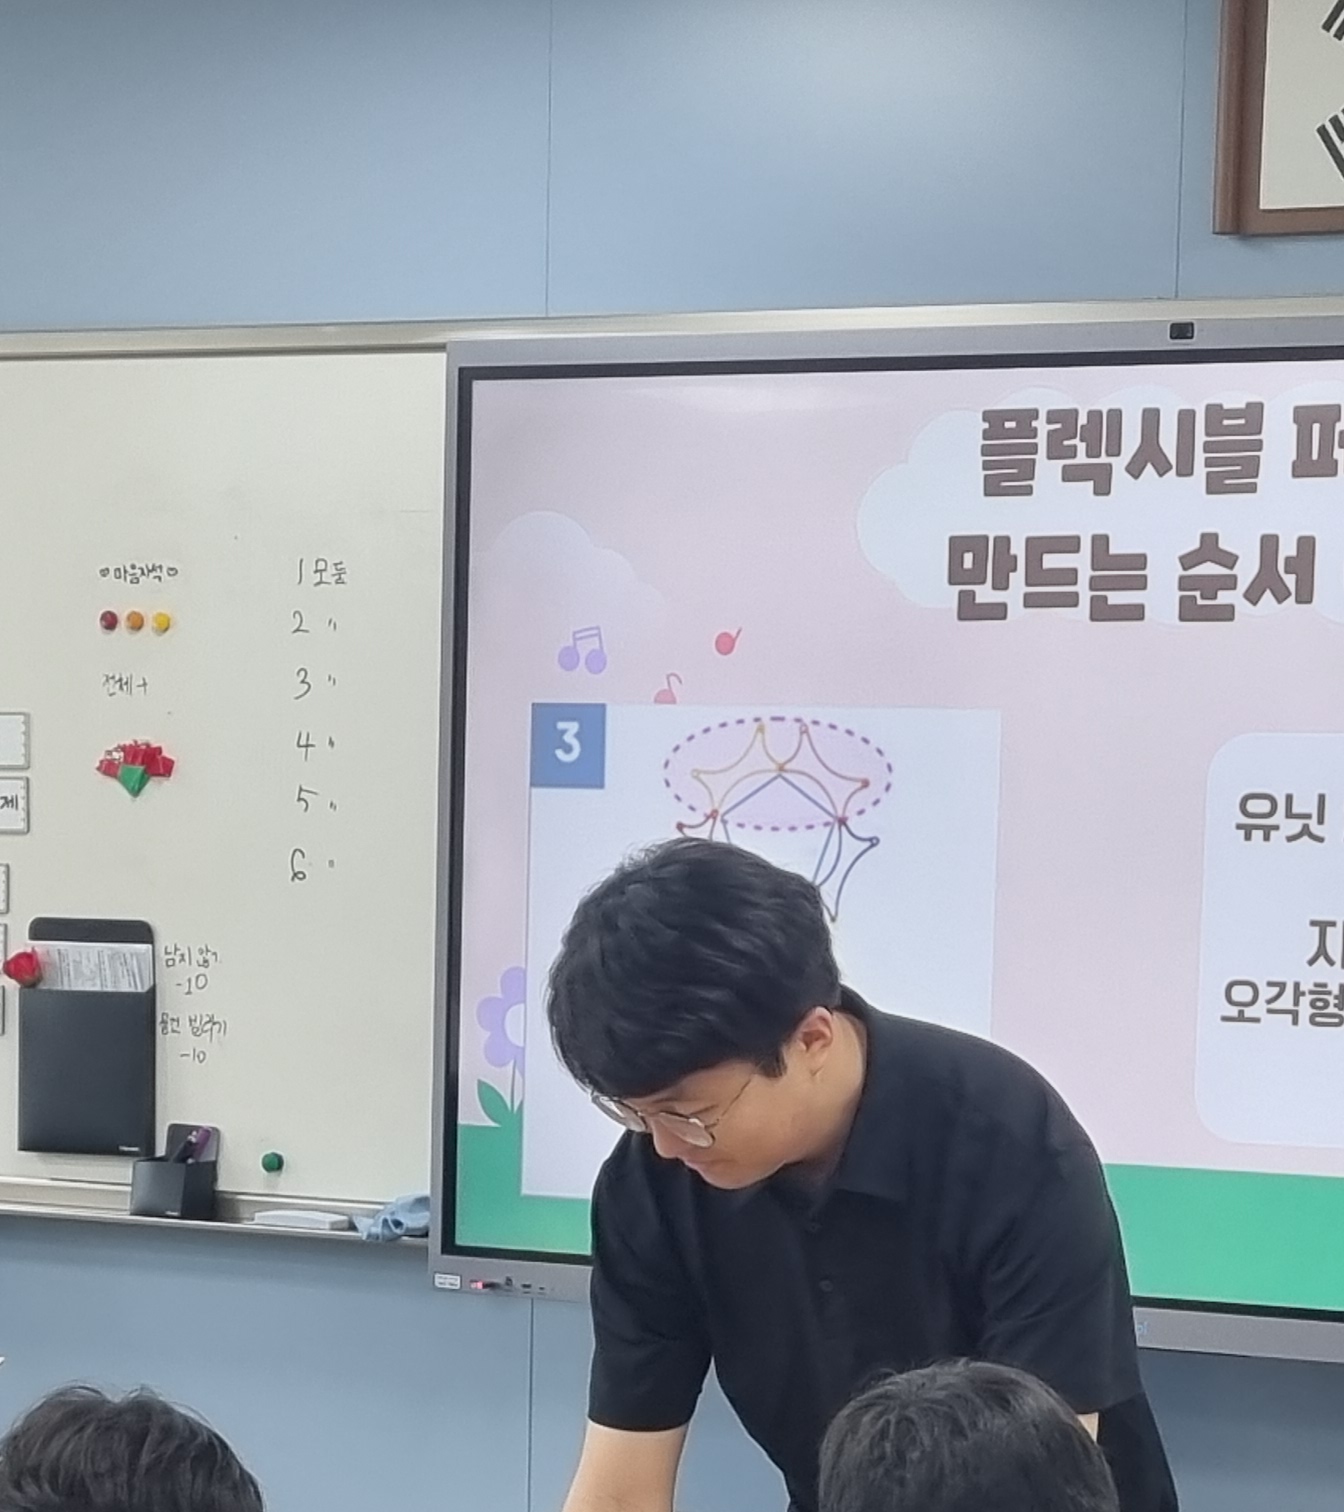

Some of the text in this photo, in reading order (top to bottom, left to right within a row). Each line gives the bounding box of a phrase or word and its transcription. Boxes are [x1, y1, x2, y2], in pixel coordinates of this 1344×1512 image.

[981, 401, 1264, 496] 플렉시블
[948, 533, 1148, 621] 만드는
[1178, 532, 1316, 621] 순서
[554, 720, 582, 763] 3
[1235, 792, 1327, 844] 유닛
